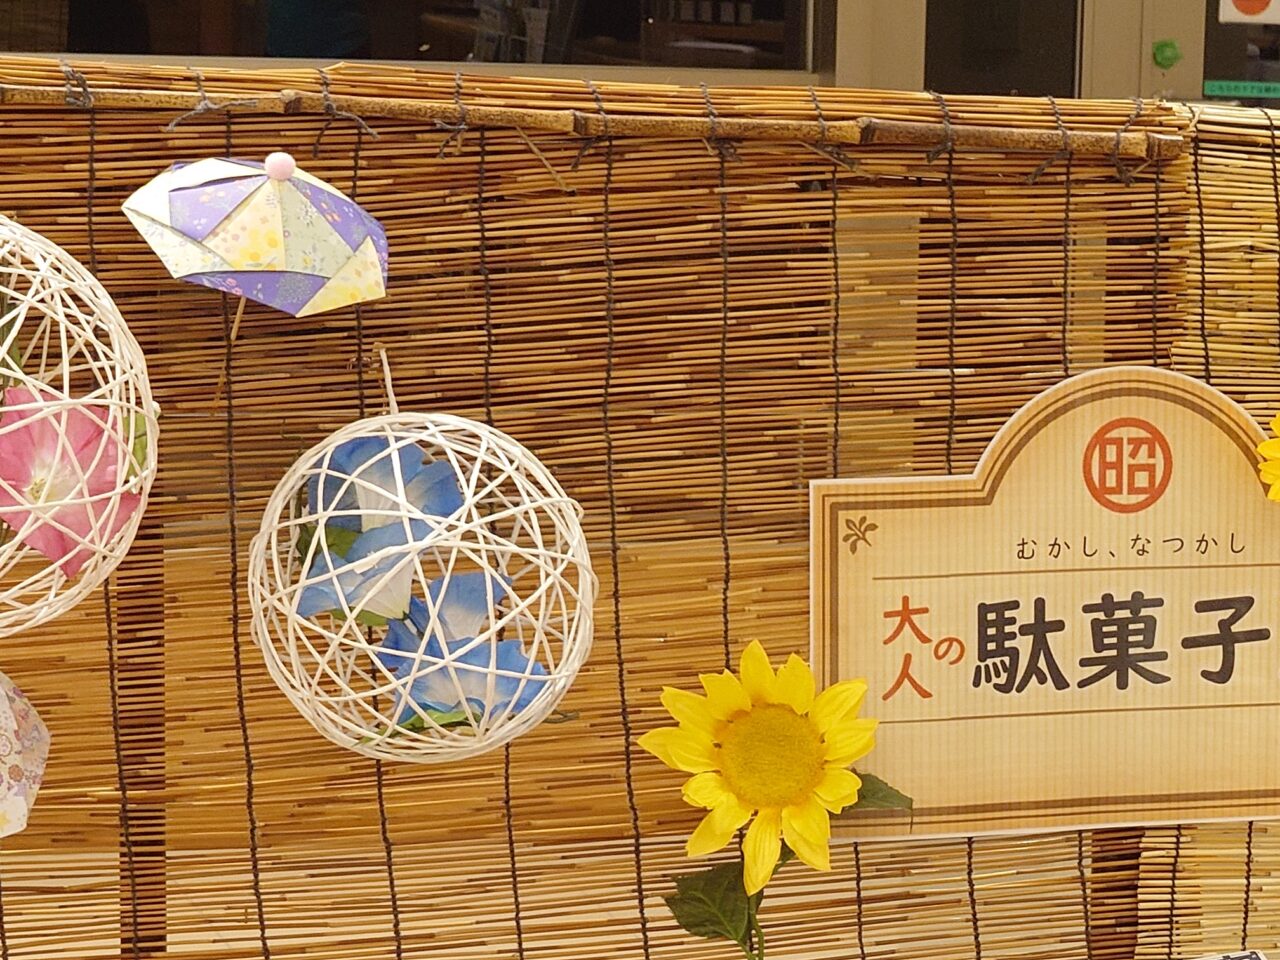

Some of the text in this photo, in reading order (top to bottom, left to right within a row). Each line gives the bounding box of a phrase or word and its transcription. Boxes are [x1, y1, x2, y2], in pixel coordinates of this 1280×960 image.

[1098, 436, 1158, 497] 昭
[1016, 531, 1248, 561] むかし、なつかし
